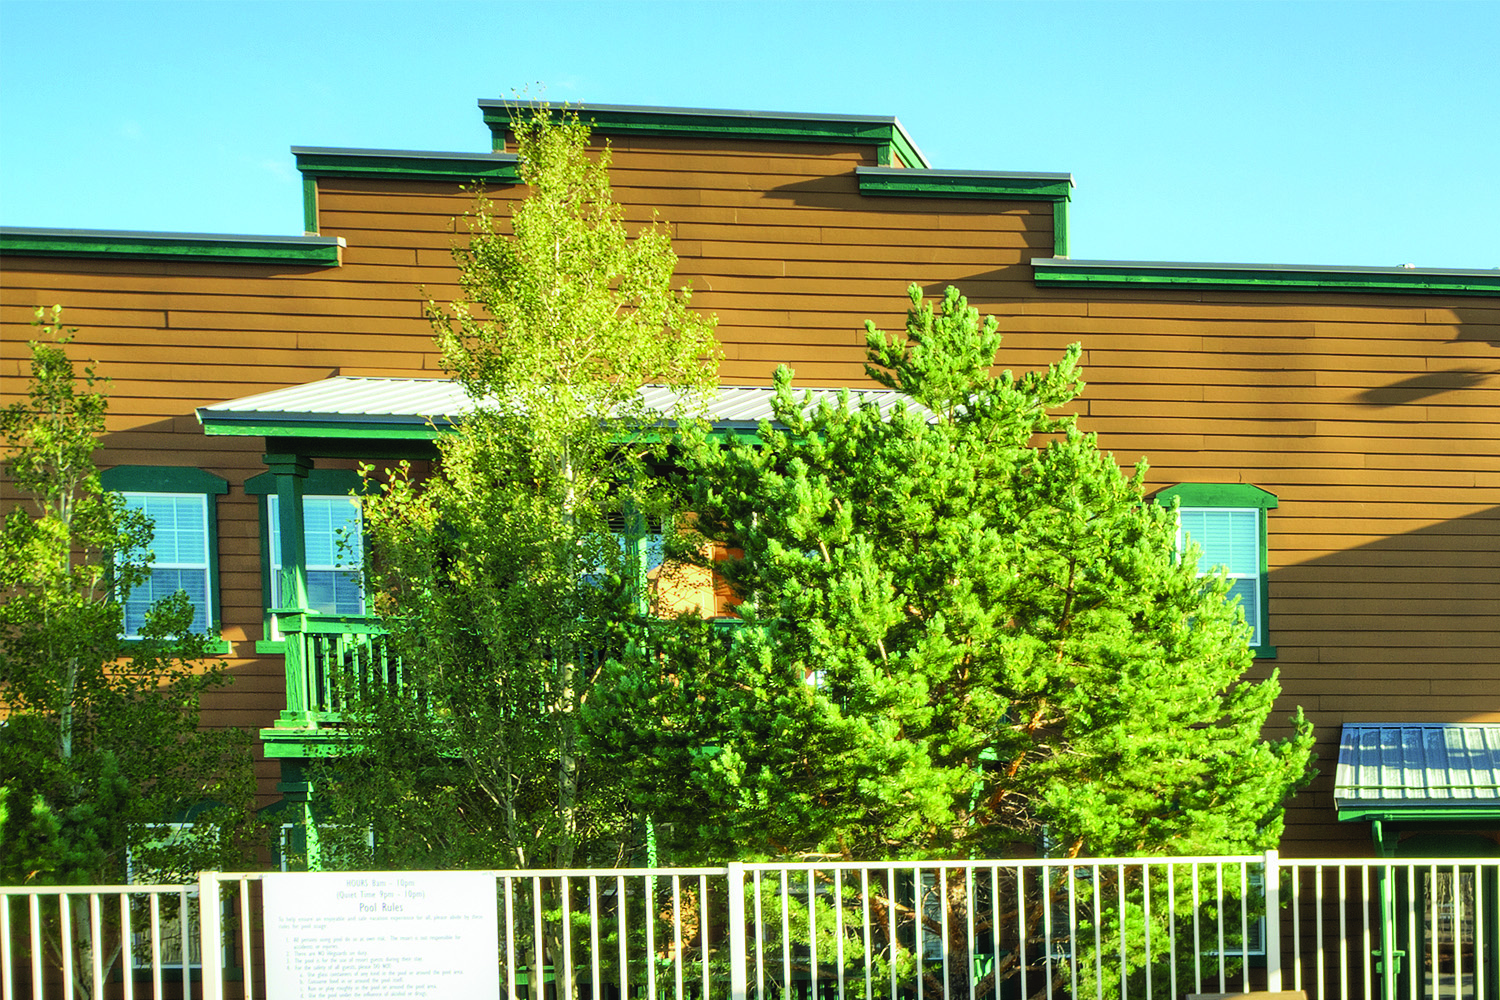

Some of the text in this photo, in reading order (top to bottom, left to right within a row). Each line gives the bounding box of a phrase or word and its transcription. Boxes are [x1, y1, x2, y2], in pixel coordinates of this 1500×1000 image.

[346, 879, 368, 887] HOURS
[372, 879, 386, 887] 8am
[397, 879, 415, 888] 10pm
[336, 890, 357, 899] (Quiet
[360, 890, 376, 898] Time
[379, 890, 394, 899] 9pm
[405, 890, 425, 899] 10pm)
[360, 902, 403, 912] Pool Rules
